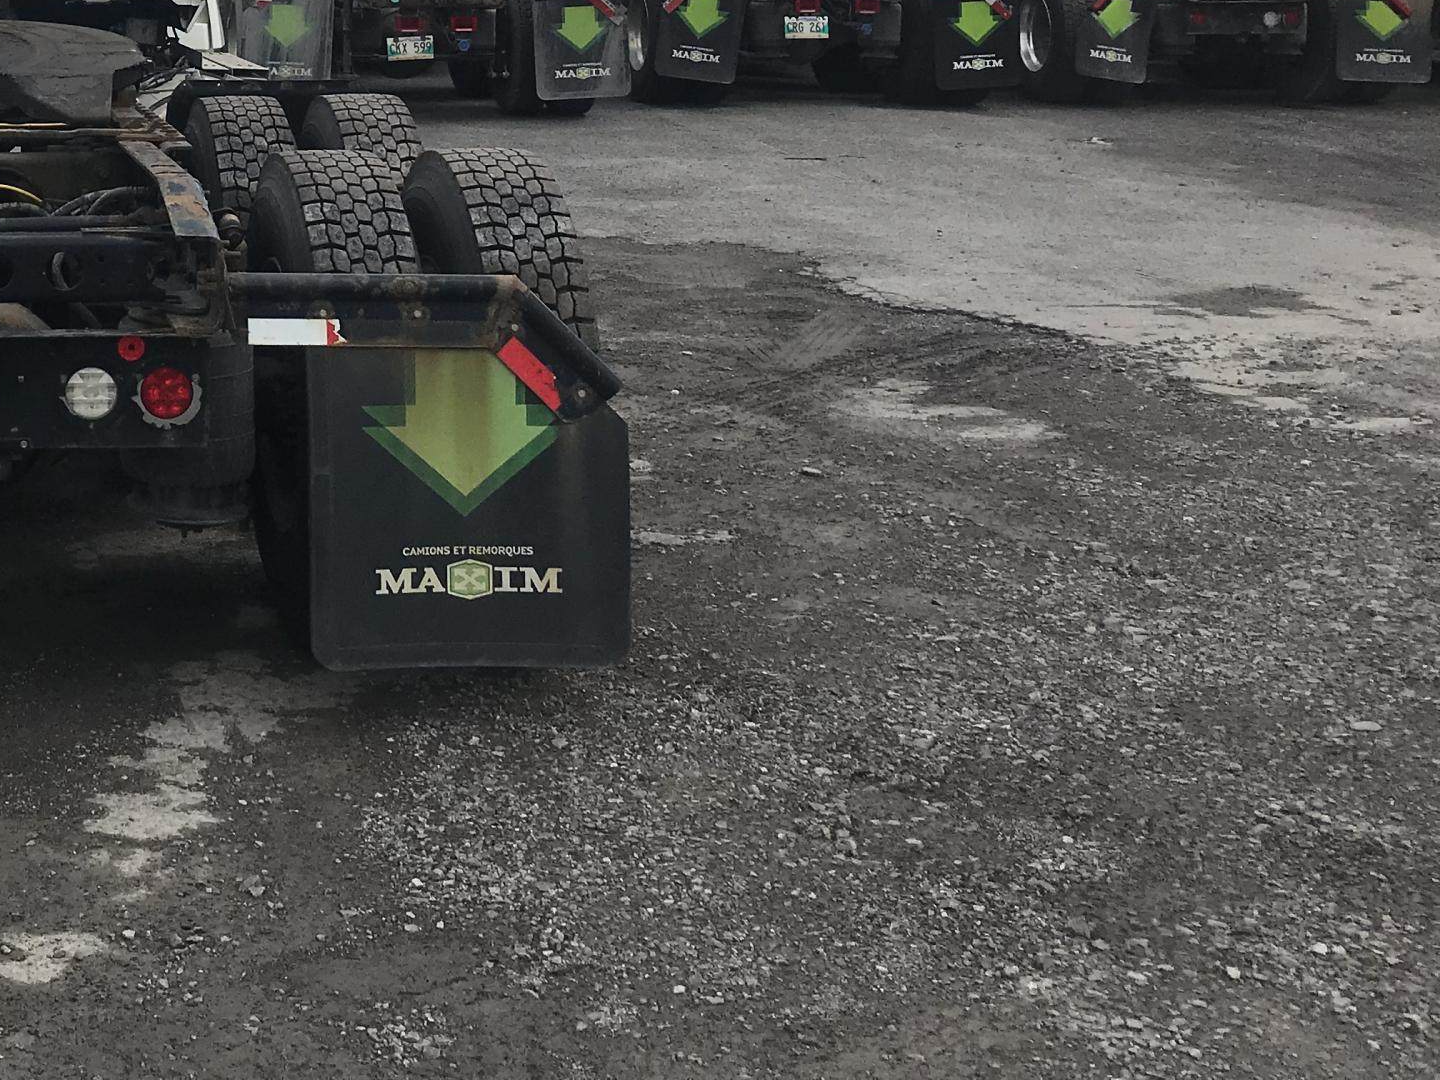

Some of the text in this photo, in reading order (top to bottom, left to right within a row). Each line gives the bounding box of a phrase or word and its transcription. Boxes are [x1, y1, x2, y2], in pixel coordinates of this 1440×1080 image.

[413, 40, 433, 54] 599
[671, 49, 721, 63] MAXIM
[1089, 49, 1132, 63] MAXIM
[1356, 52, 1412, 64] MAXIM
[952, 58, 1004, 70] MAXIM
[554, 67, 611, 80] MAXIM
[402, 545, 534, 557] CAMIONS ET REMORQUES
[375, 558, 563, 600] MAXIM
